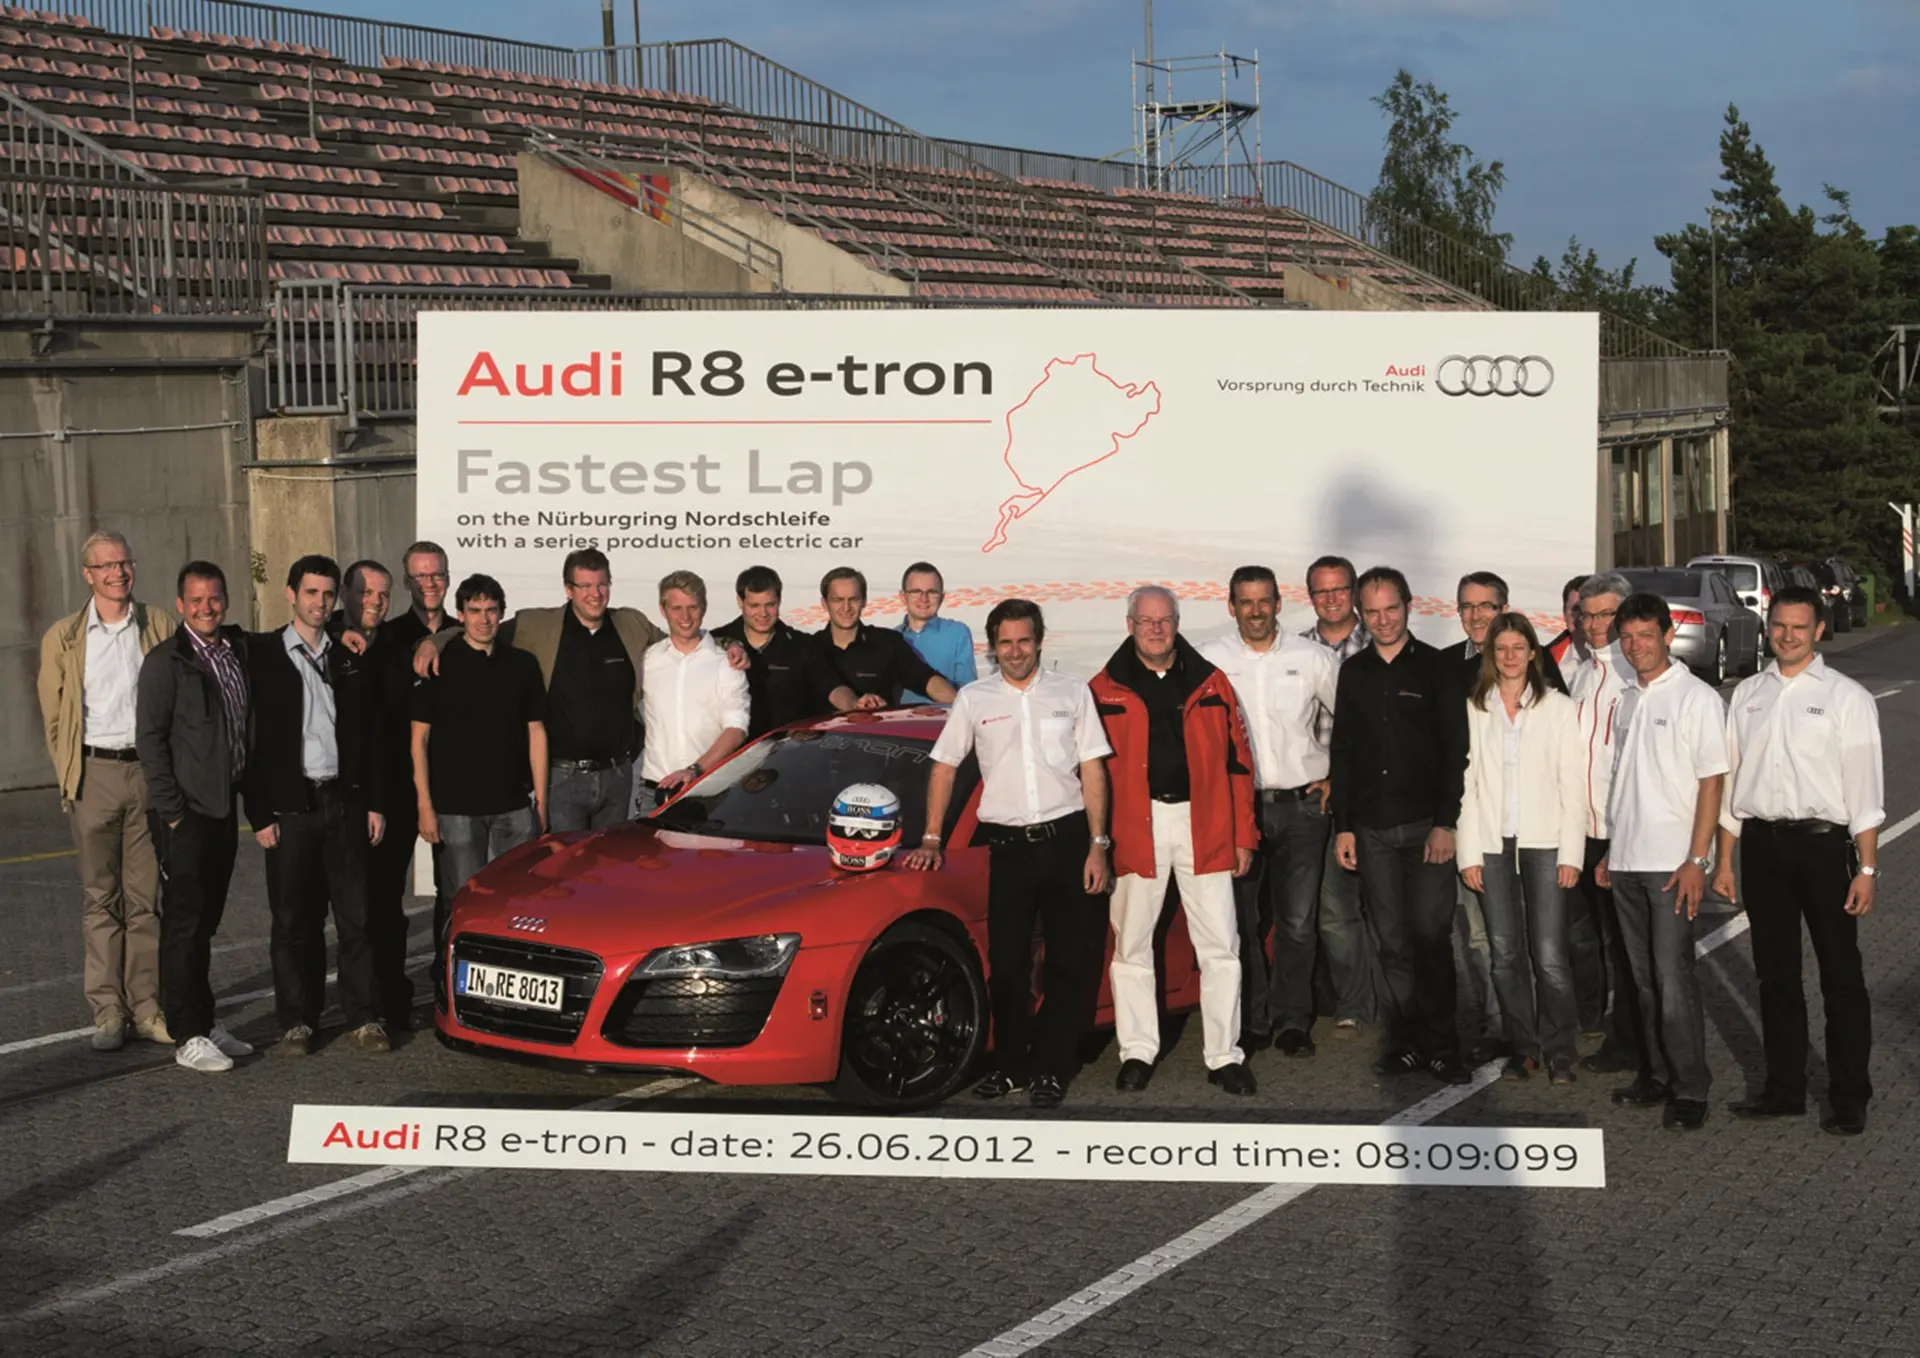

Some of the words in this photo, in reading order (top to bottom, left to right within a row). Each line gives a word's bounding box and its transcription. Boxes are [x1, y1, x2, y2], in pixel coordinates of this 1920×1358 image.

[455, 350, 623, 397] Audi
[651, 349, 746, 397] R8
[765, 354, 993, 397] e-tron
[1385, 364, 1426, 377] Audi
[1217, 379, 1305, 395] Vorsprung
[1309, 379, 1358, 393] durch
[1362, 379, 1425, 393] Technik
[457, 449, 721, 495] Fastest
[748, 449, 873, 506] Lap
[456, 514, 485, 527] on
[492, 511, 531, 527] the
[537, 510, 677, 531] Nürburgring
[685, 510, 831, 527] Nordschleife
[456, 533, 507, 549] with
[513, 536, 526, 549] a
[533, 536, 601, 549] series
[606, 533, 731, 553] production
[738, 533, 822, 549] electric
[828, 536, 864, 549] car
[846, 805, 872, 815] BOSS
[841, 854, 866, 865] BOSS
[467, 967, 487, 993] IN
[495, 972, 516, 999] RE
[519, 976, 559, 1005] 8013
[322, 1121, 421, 1151] Audi
[434, 1124, 487, 1152] R8
[500, 1129, 627, 1155] e-tron
[670, 1129, 774, 1159] date:
[789, 1131, 1035, 1164] 26.06.2012
[1086, 1138, 1218, 1167] record
[1232, 1139, 1340, 1169] time:
[1355, 1141, 1578, 1172] 08:09:099
